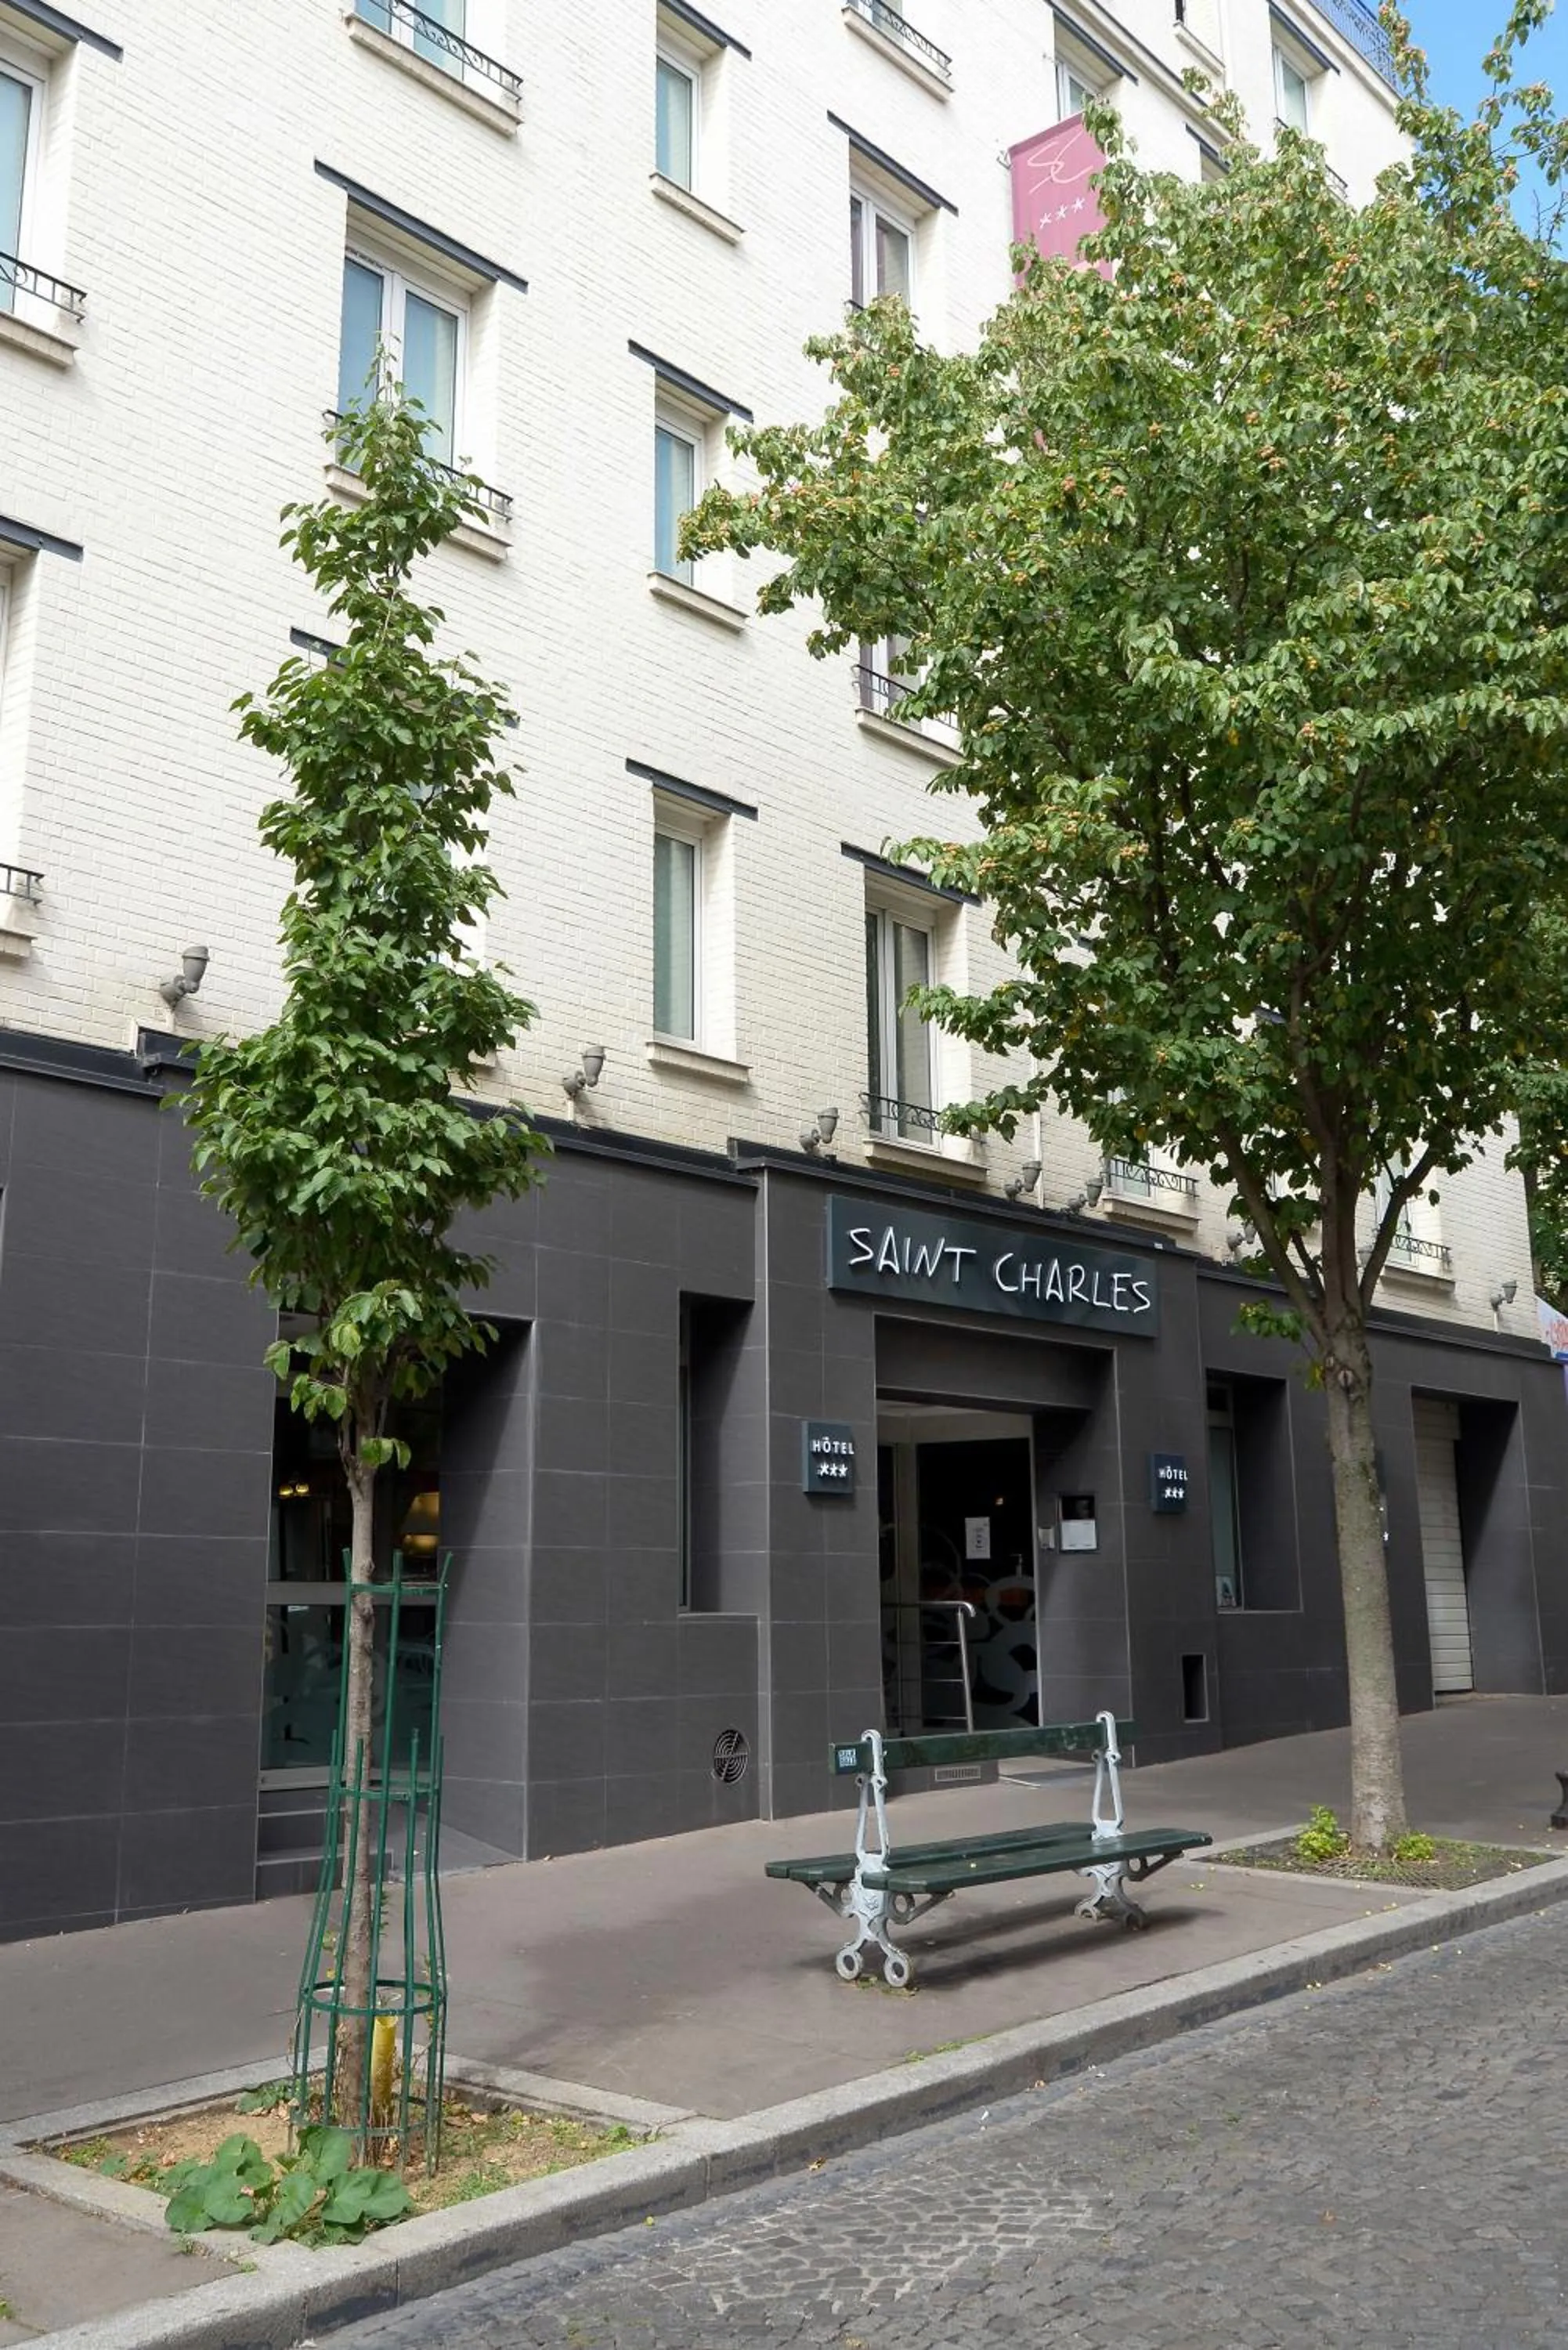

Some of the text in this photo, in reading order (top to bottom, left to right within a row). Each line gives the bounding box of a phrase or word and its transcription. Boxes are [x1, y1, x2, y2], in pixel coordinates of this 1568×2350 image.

[848, 1226, 1151, 1314] SAINT CHARLES
[811, 1436, 854, 1455] HÔTEL
[1158, 1466, 1188, 1481] HÔTEL
